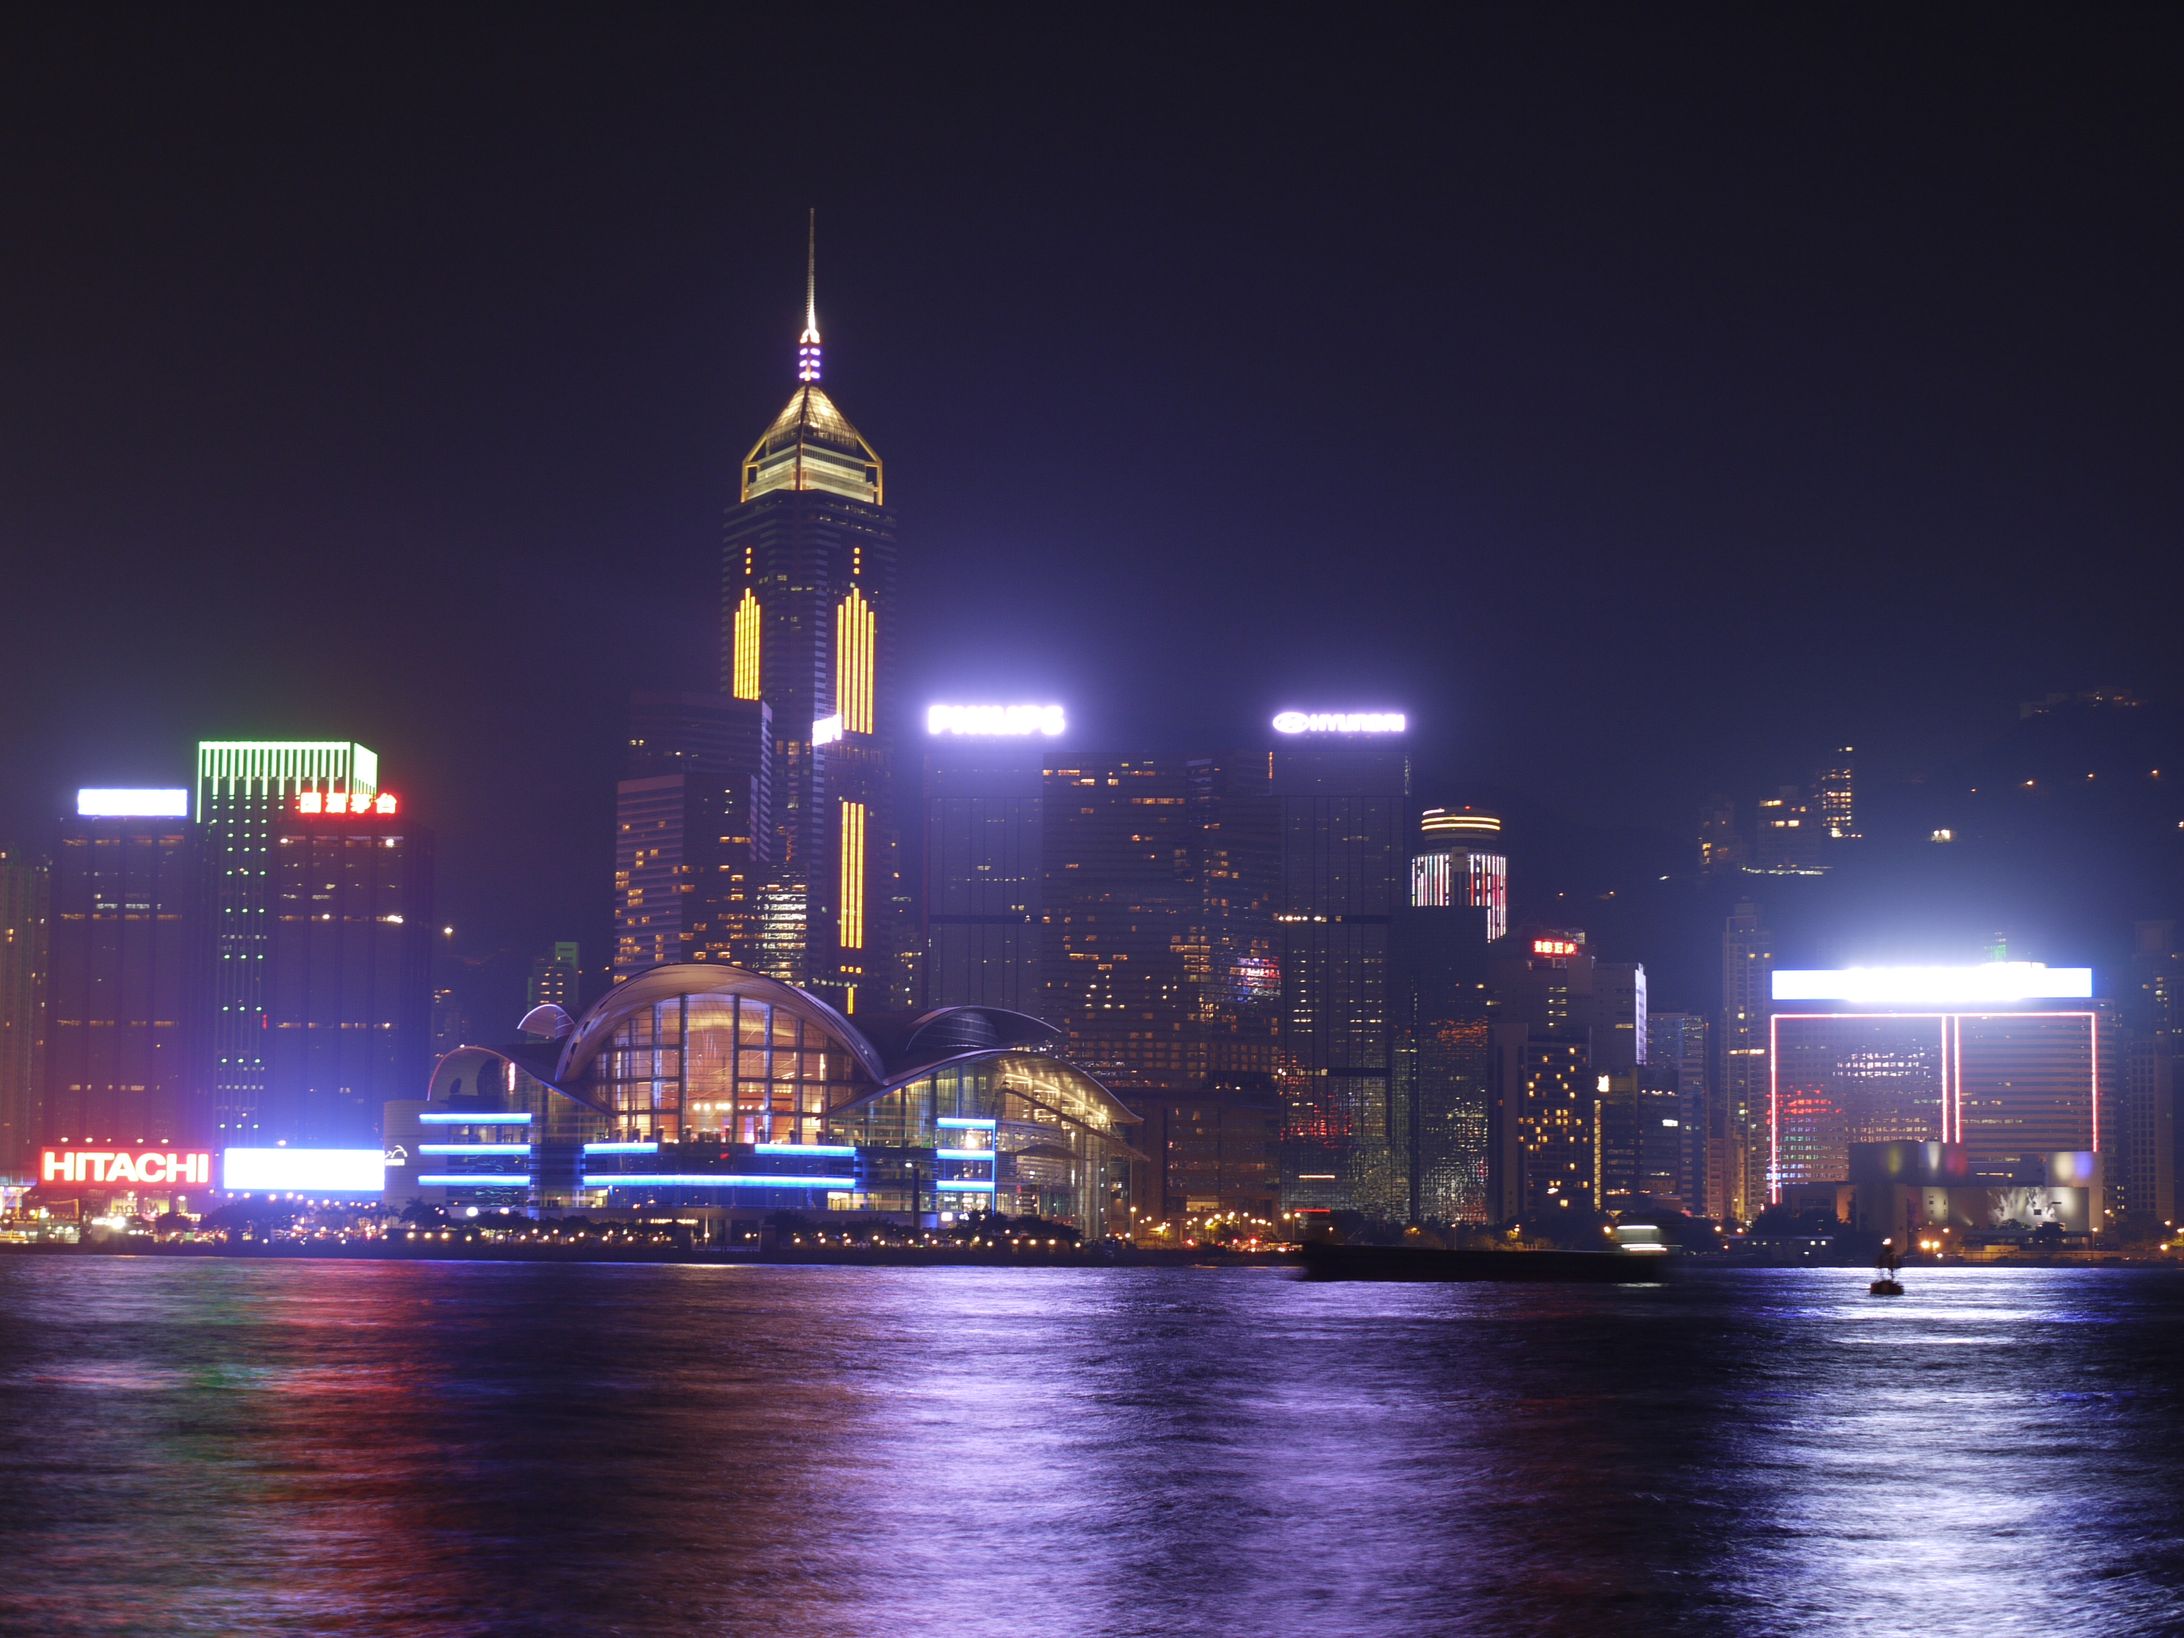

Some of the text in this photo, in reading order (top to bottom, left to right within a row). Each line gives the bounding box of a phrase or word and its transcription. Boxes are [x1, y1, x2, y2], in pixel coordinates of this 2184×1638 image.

[927, 704, 1066, 736] PHILIPS
[1309, 713, 1406, 732] HYUNDAI
[44, 1152, 209, 1183] HITACHI
